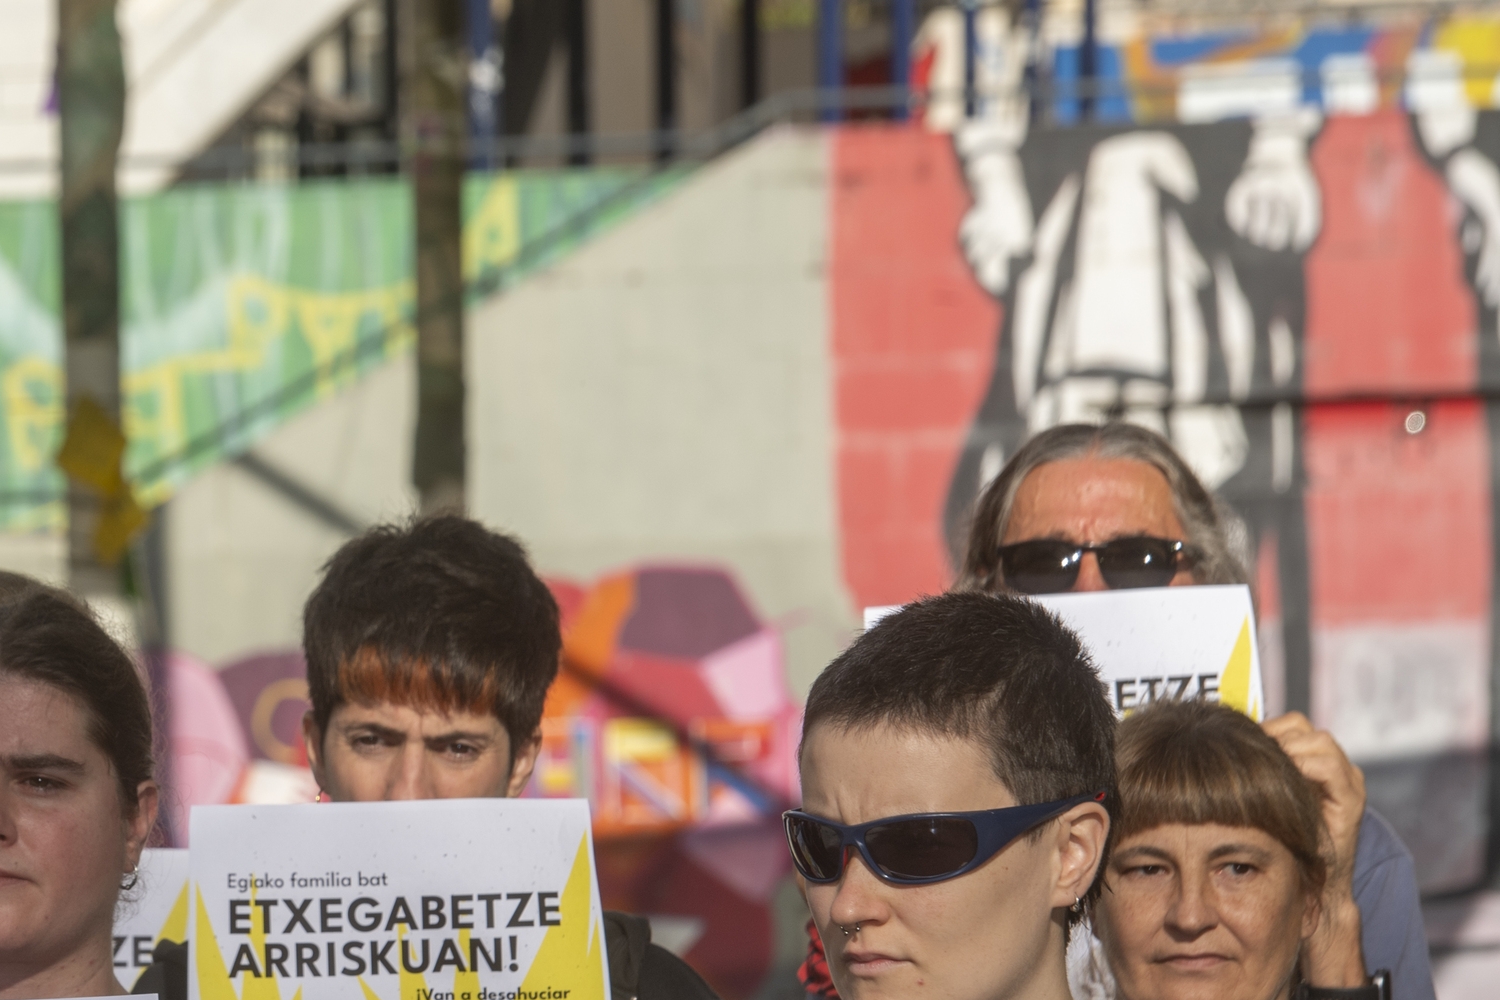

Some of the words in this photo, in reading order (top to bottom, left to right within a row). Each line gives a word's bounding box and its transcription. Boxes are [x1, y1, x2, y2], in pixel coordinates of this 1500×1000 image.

[227, 872, 285, 894] Egiako
[289, 871, 352, 889] familia
[357, 871, 388, 887] bat
[229, 891, 561, 935] ETXEGABETZE
[228, 935, 519, 979] ARRISKUAN!
[460, 991, 472, 1000] a
